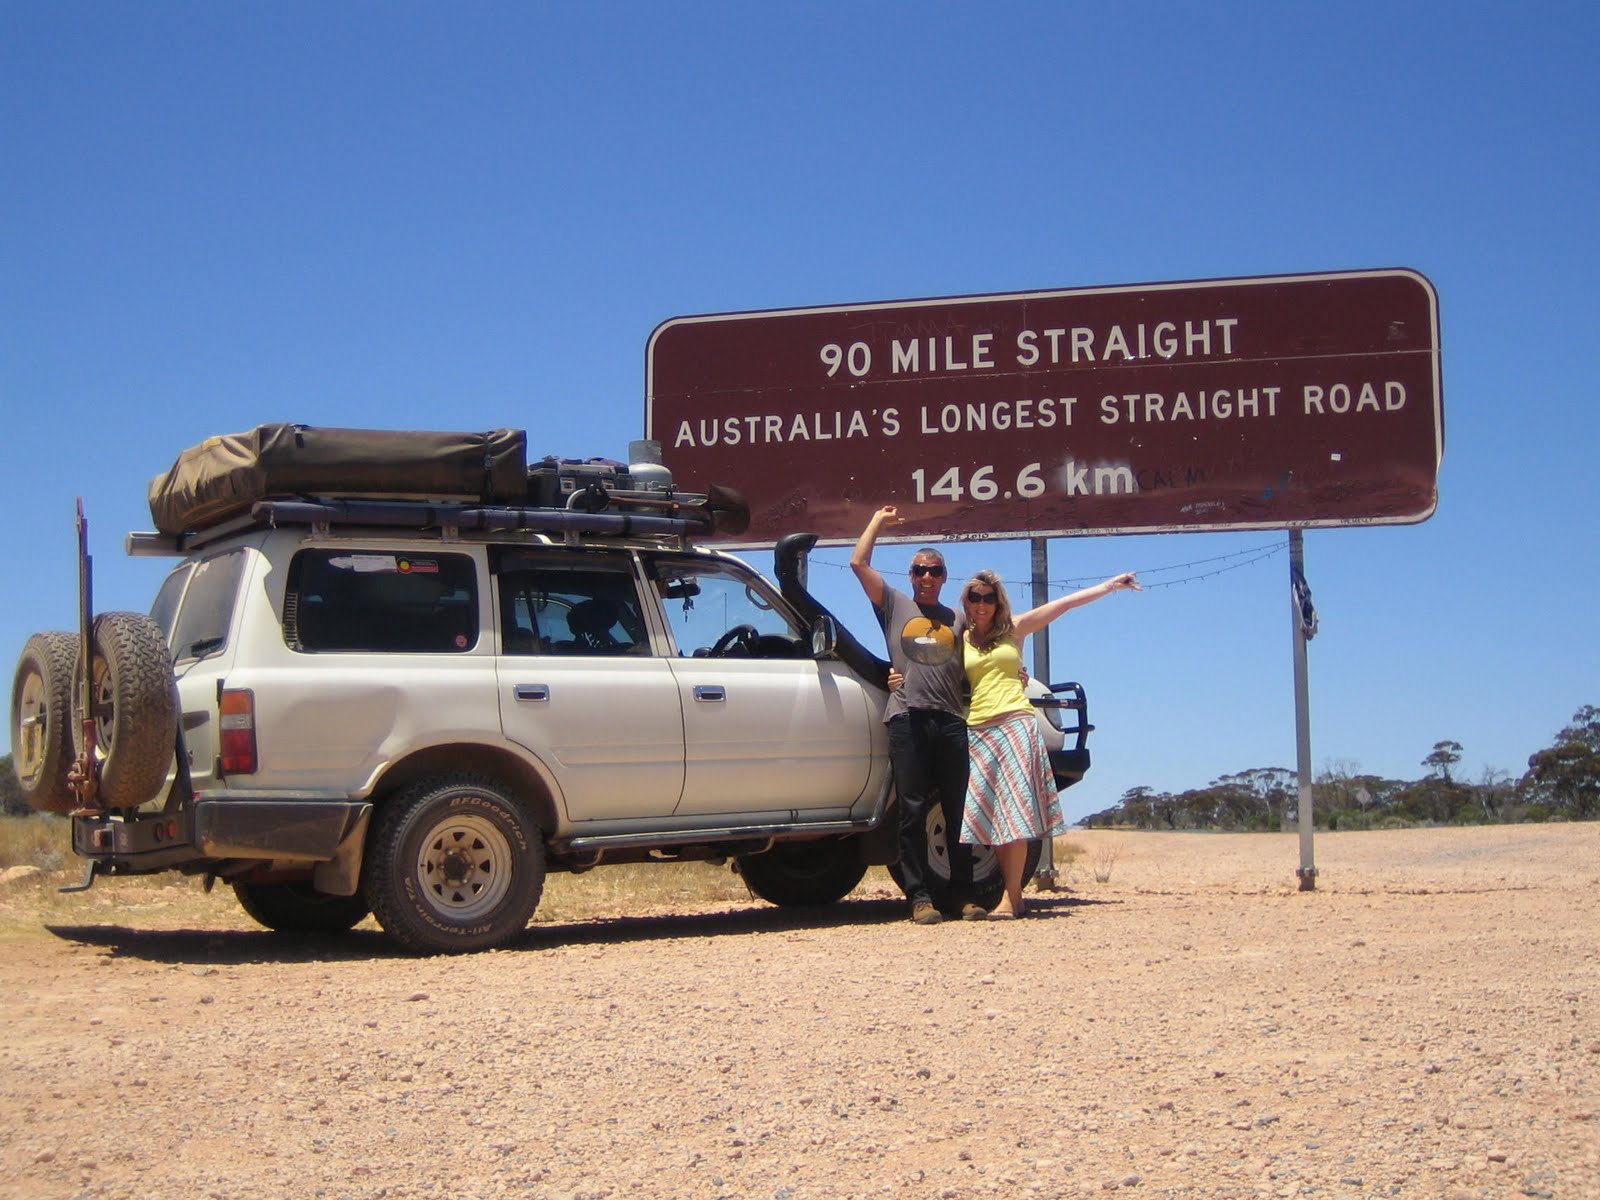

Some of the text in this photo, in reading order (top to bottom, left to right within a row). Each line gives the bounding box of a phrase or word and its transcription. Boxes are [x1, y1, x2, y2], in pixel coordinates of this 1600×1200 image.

[820, 341, 872, 378] 90
[892, 333, 995, 374] MILE
[1016, 318, 1239, 366] STRAIGHT
[674, 381, 1407, 448] AUSTRALIA'S LONGEST STRAIGHT ROAD
[911, 460, 1133, 503] 146.6 km
[450, 797, 529, 851] BFGoodrich
